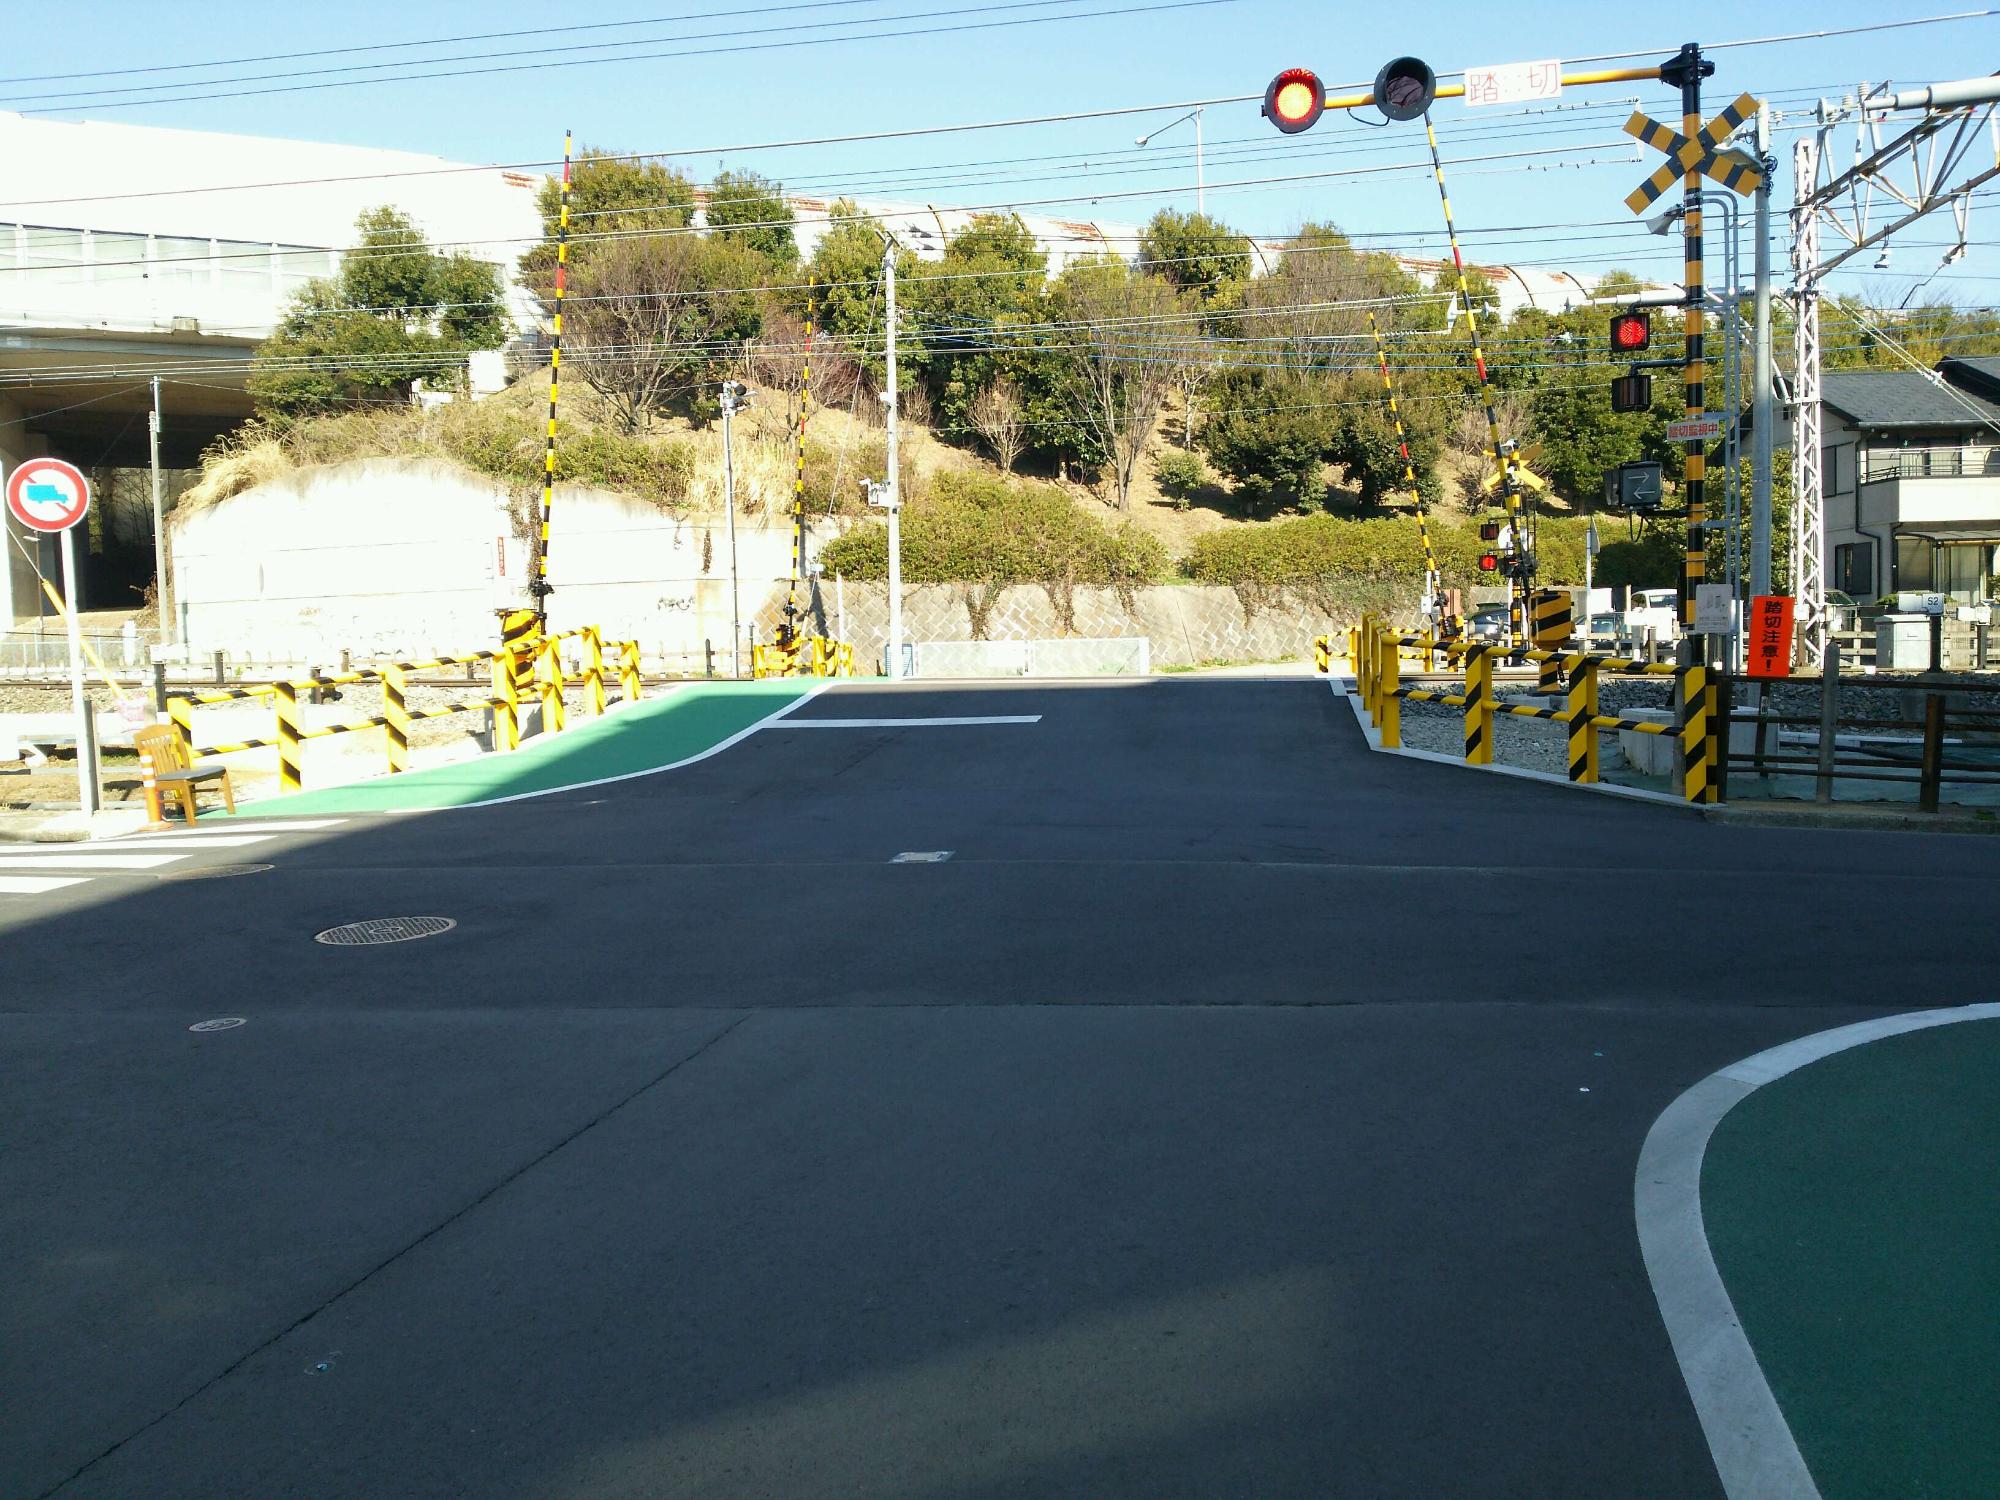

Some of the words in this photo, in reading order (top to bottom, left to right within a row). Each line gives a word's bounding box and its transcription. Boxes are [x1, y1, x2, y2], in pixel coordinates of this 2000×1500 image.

[1470, 63, 1558, 102] 踏切
[1668, 422, 1717, 438] 踏切監視中
[1927, 597, 1939, 606] S2
[1761, 600, 1783, 672] 踏切注意!
